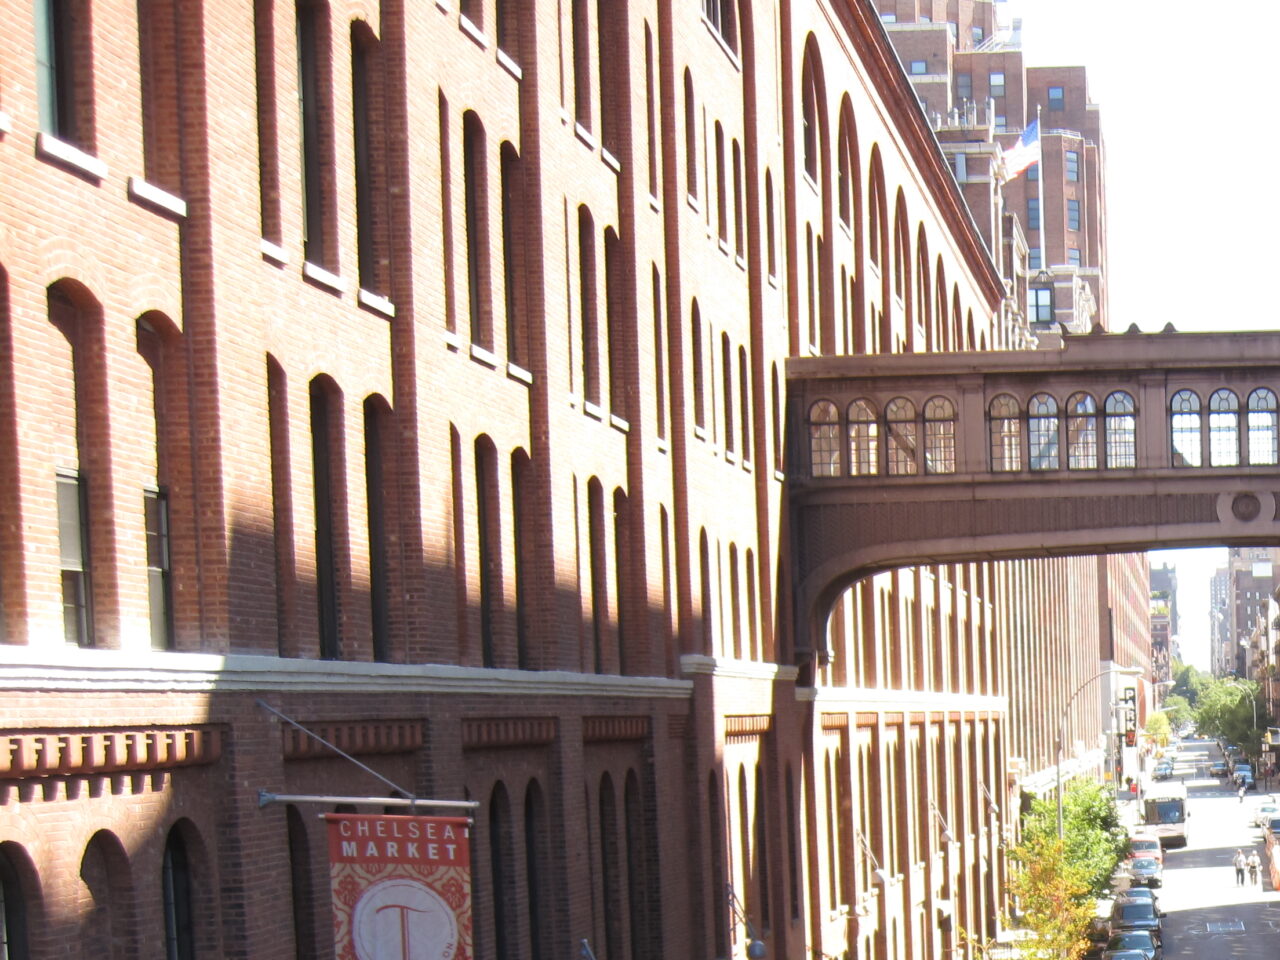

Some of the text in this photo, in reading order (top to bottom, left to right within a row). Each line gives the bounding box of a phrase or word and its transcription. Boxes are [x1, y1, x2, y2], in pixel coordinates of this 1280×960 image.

[1126, 689, 1135, 731] PARK
[340, 821, 455, 840] CHELSEA
[342, 841, 456, 860] MARKET
